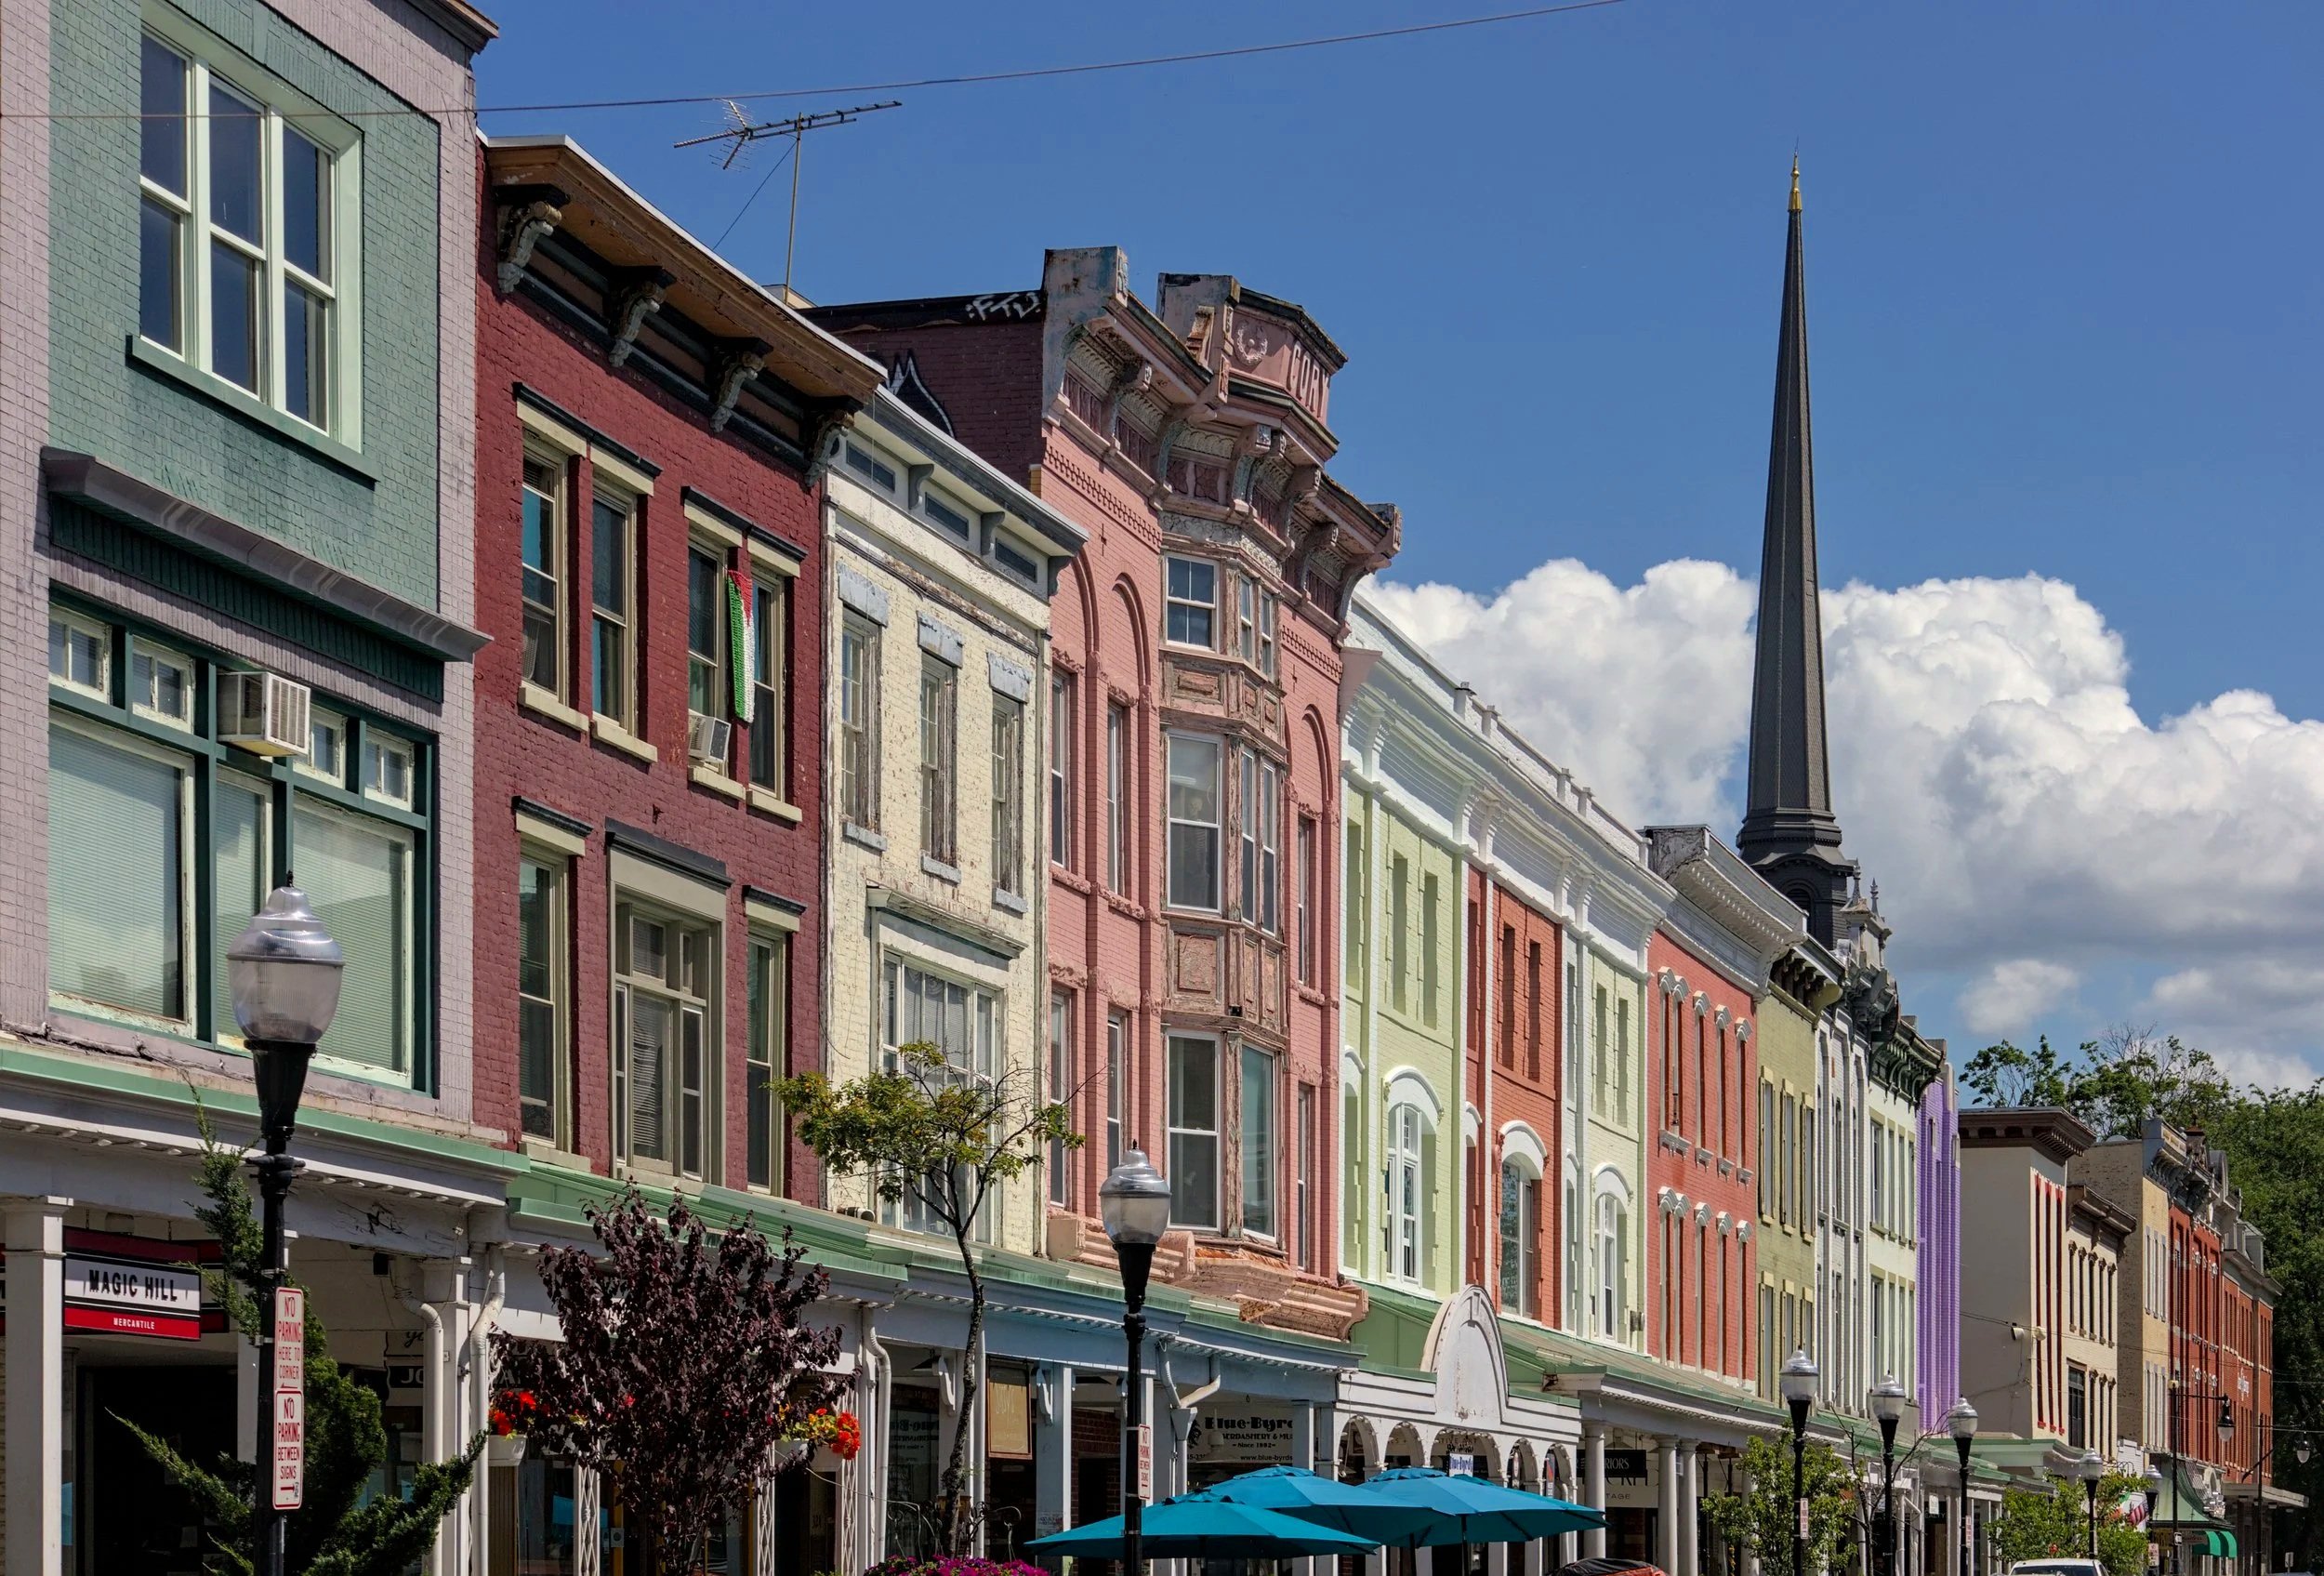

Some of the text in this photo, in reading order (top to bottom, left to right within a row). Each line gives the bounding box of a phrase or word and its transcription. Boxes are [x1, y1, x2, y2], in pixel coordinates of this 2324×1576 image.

[1289, 340, 1329, 418] CORY
[89, 1269, 178, 1302] MAGIC HILL
[284, 1296, 296, 1318] NO
[112, 1317, 155, 1330] MERCANTILE
[279, 1321, 301, 1343] PARKING
[279, 1346, 300, 1361] HERE TO
[279, 1365, 299, 1380] CORNER
[284, 1397, 295, 1419] NO
[278, 1422, 300, 1442] PARKING
[278, 1447, 300, 1461] BETWEEN
[1240, 1454, 1293, 1463] www.blue-byrds
[1605, 1457, 1630, 1469] RIORS
[281, 1465, 297, 1479] SIGNS
